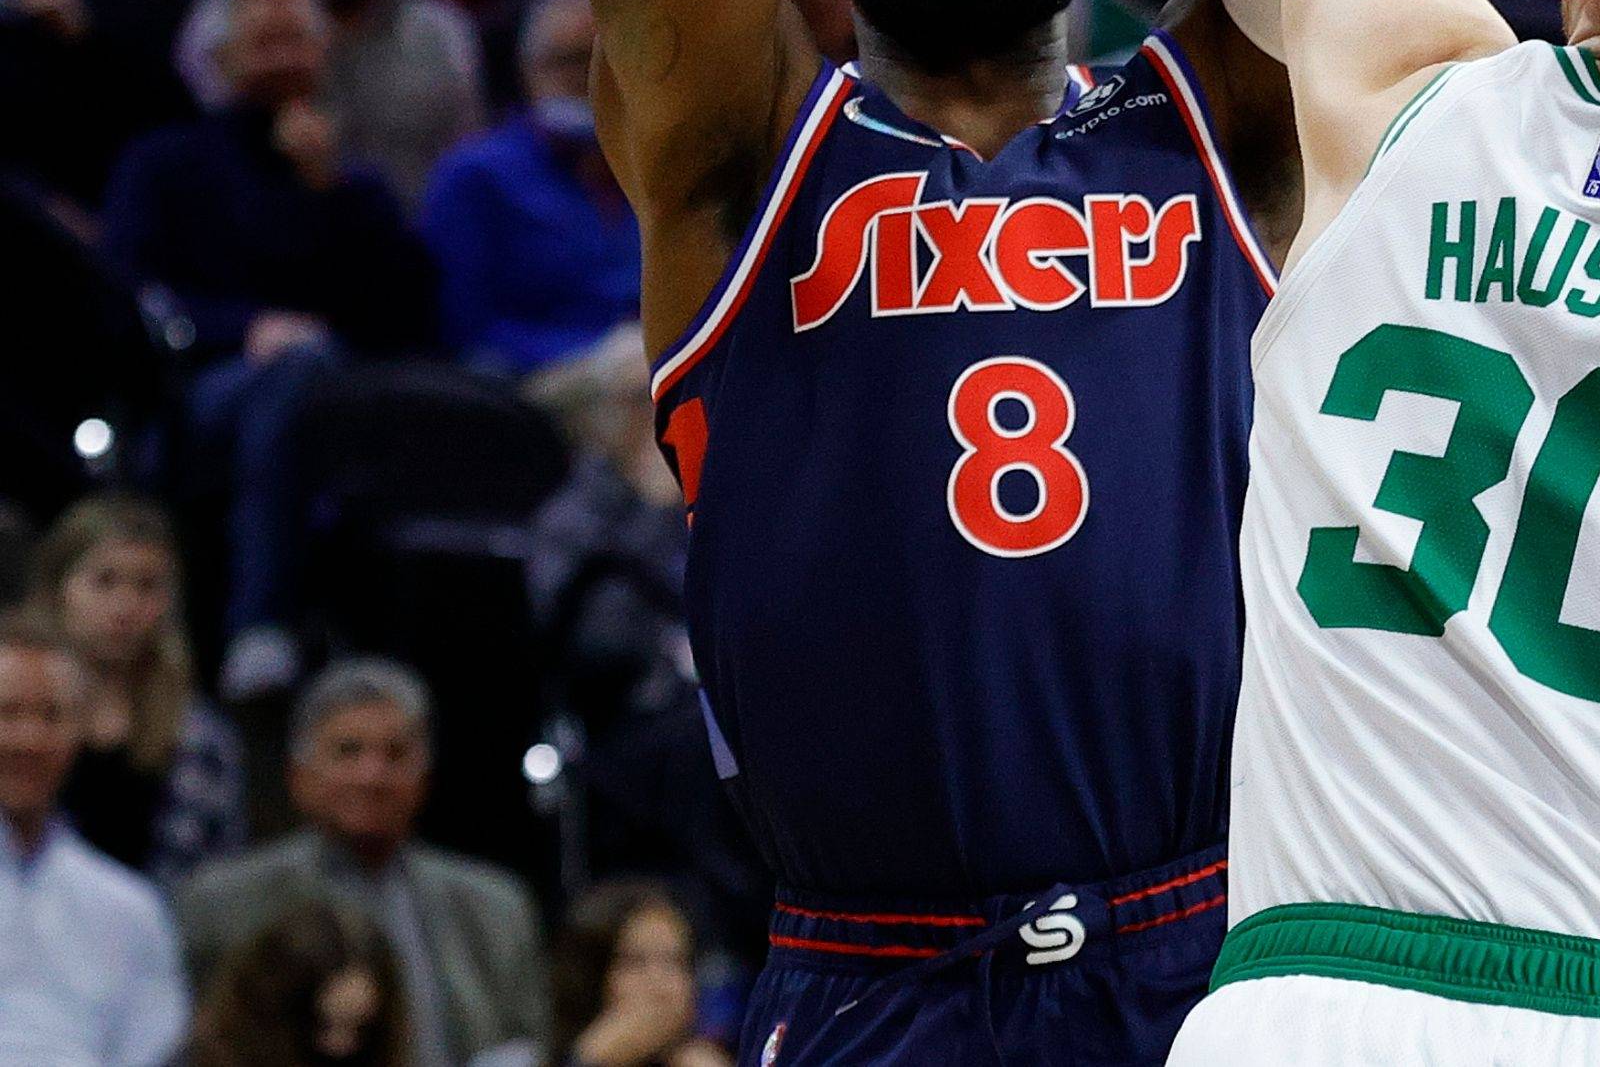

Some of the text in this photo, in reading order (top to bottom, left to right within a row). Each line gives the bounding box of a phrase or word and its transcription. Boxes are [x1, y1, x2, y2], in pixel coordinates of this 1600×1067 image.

[790, 172, 1201, 333] Sixers
[1586, 180, 1600, 195] 75
[947, 356, 1089, 558] 8
